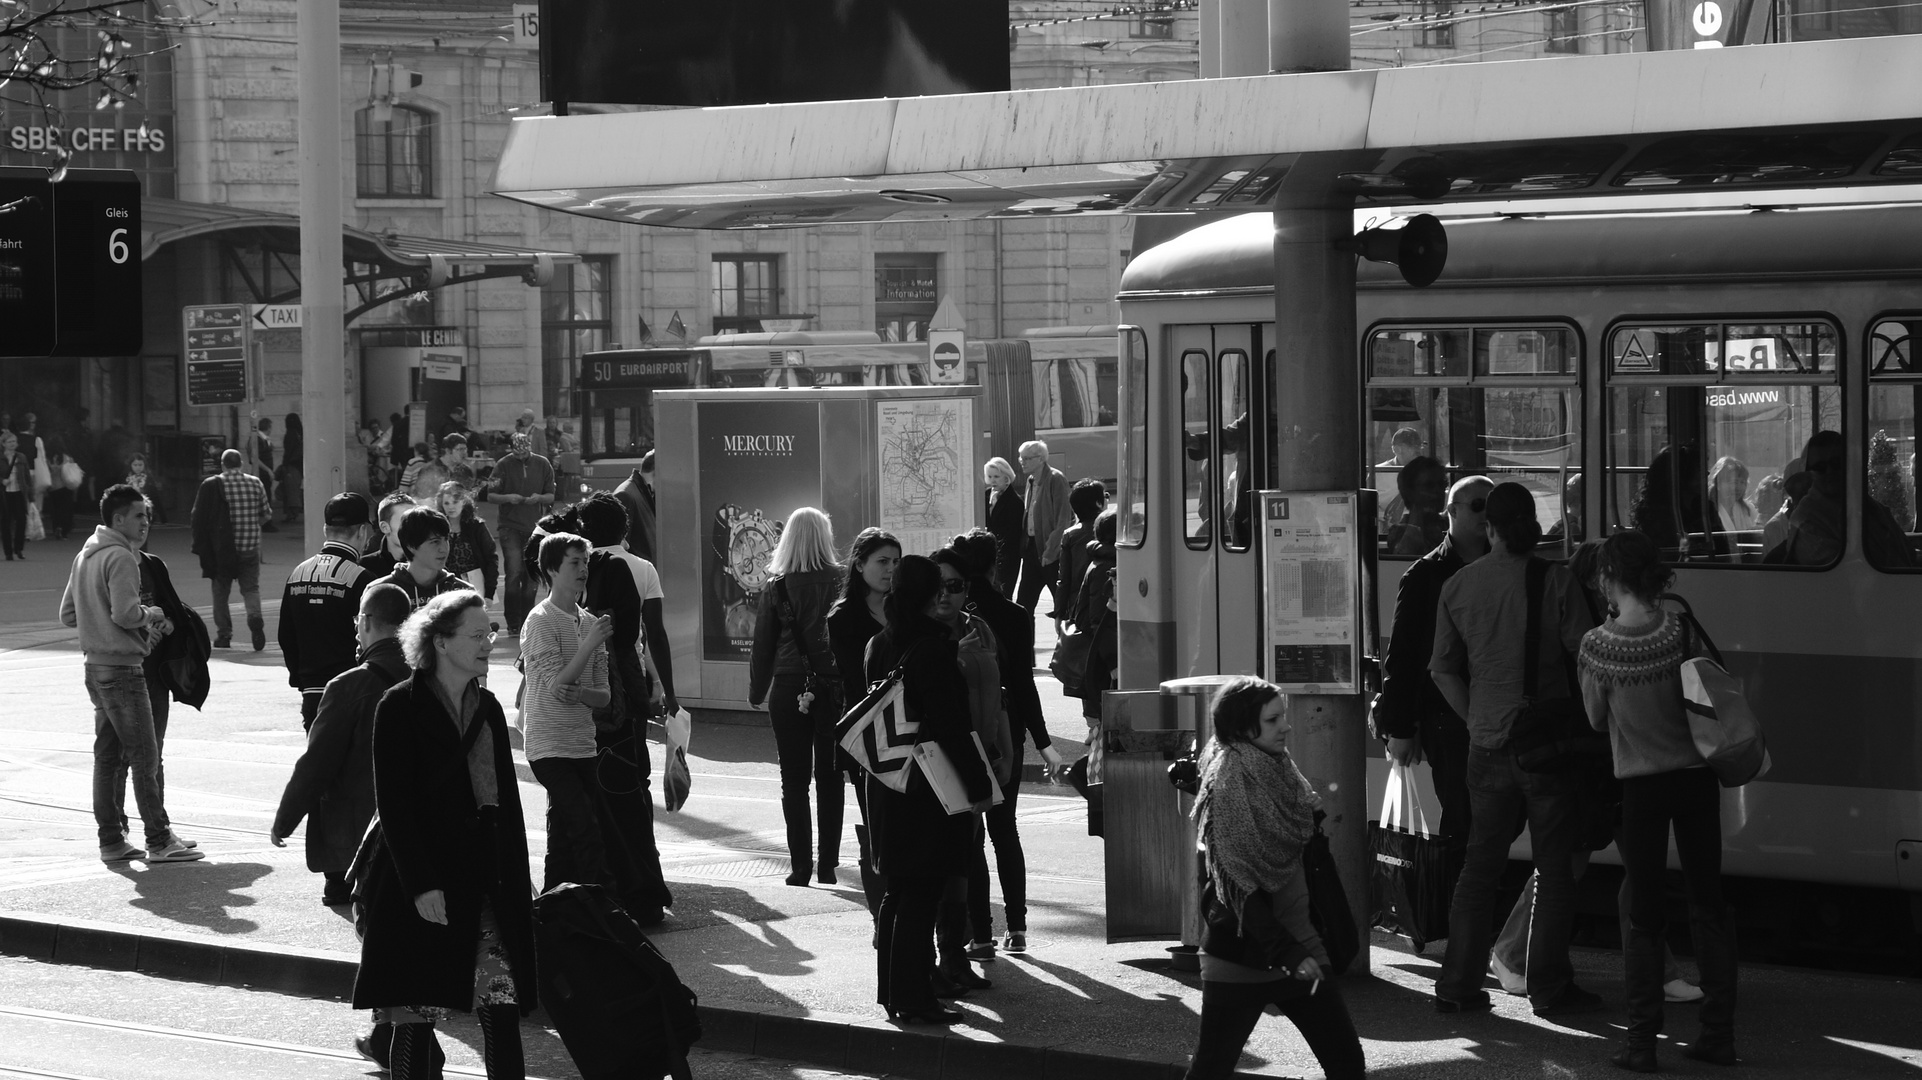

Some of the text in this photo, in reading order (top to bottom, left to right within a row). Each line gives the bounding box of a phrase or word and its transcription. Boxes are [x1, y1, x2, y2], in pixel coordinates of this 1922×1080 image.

[521, 12, 538, 37] 15
[11, 126, 165, 152] SBB CFF FFS
[105, 207, 129, 218] Gleis
[108, 228, 130, 264] 6
[887, 288, 935, 299] Information
[270, 308, 298, 324] TAXI
[421, 330, 431, 346] LE
[594, 361, 689, 381] 50 EUROAIRPORT
[723, 435, 795, 452] MERCURY
[1271, 501, 1286, 517] 11
[308, 584, 326, 595] Fashion
[326, 585, 345, 599] Brand
